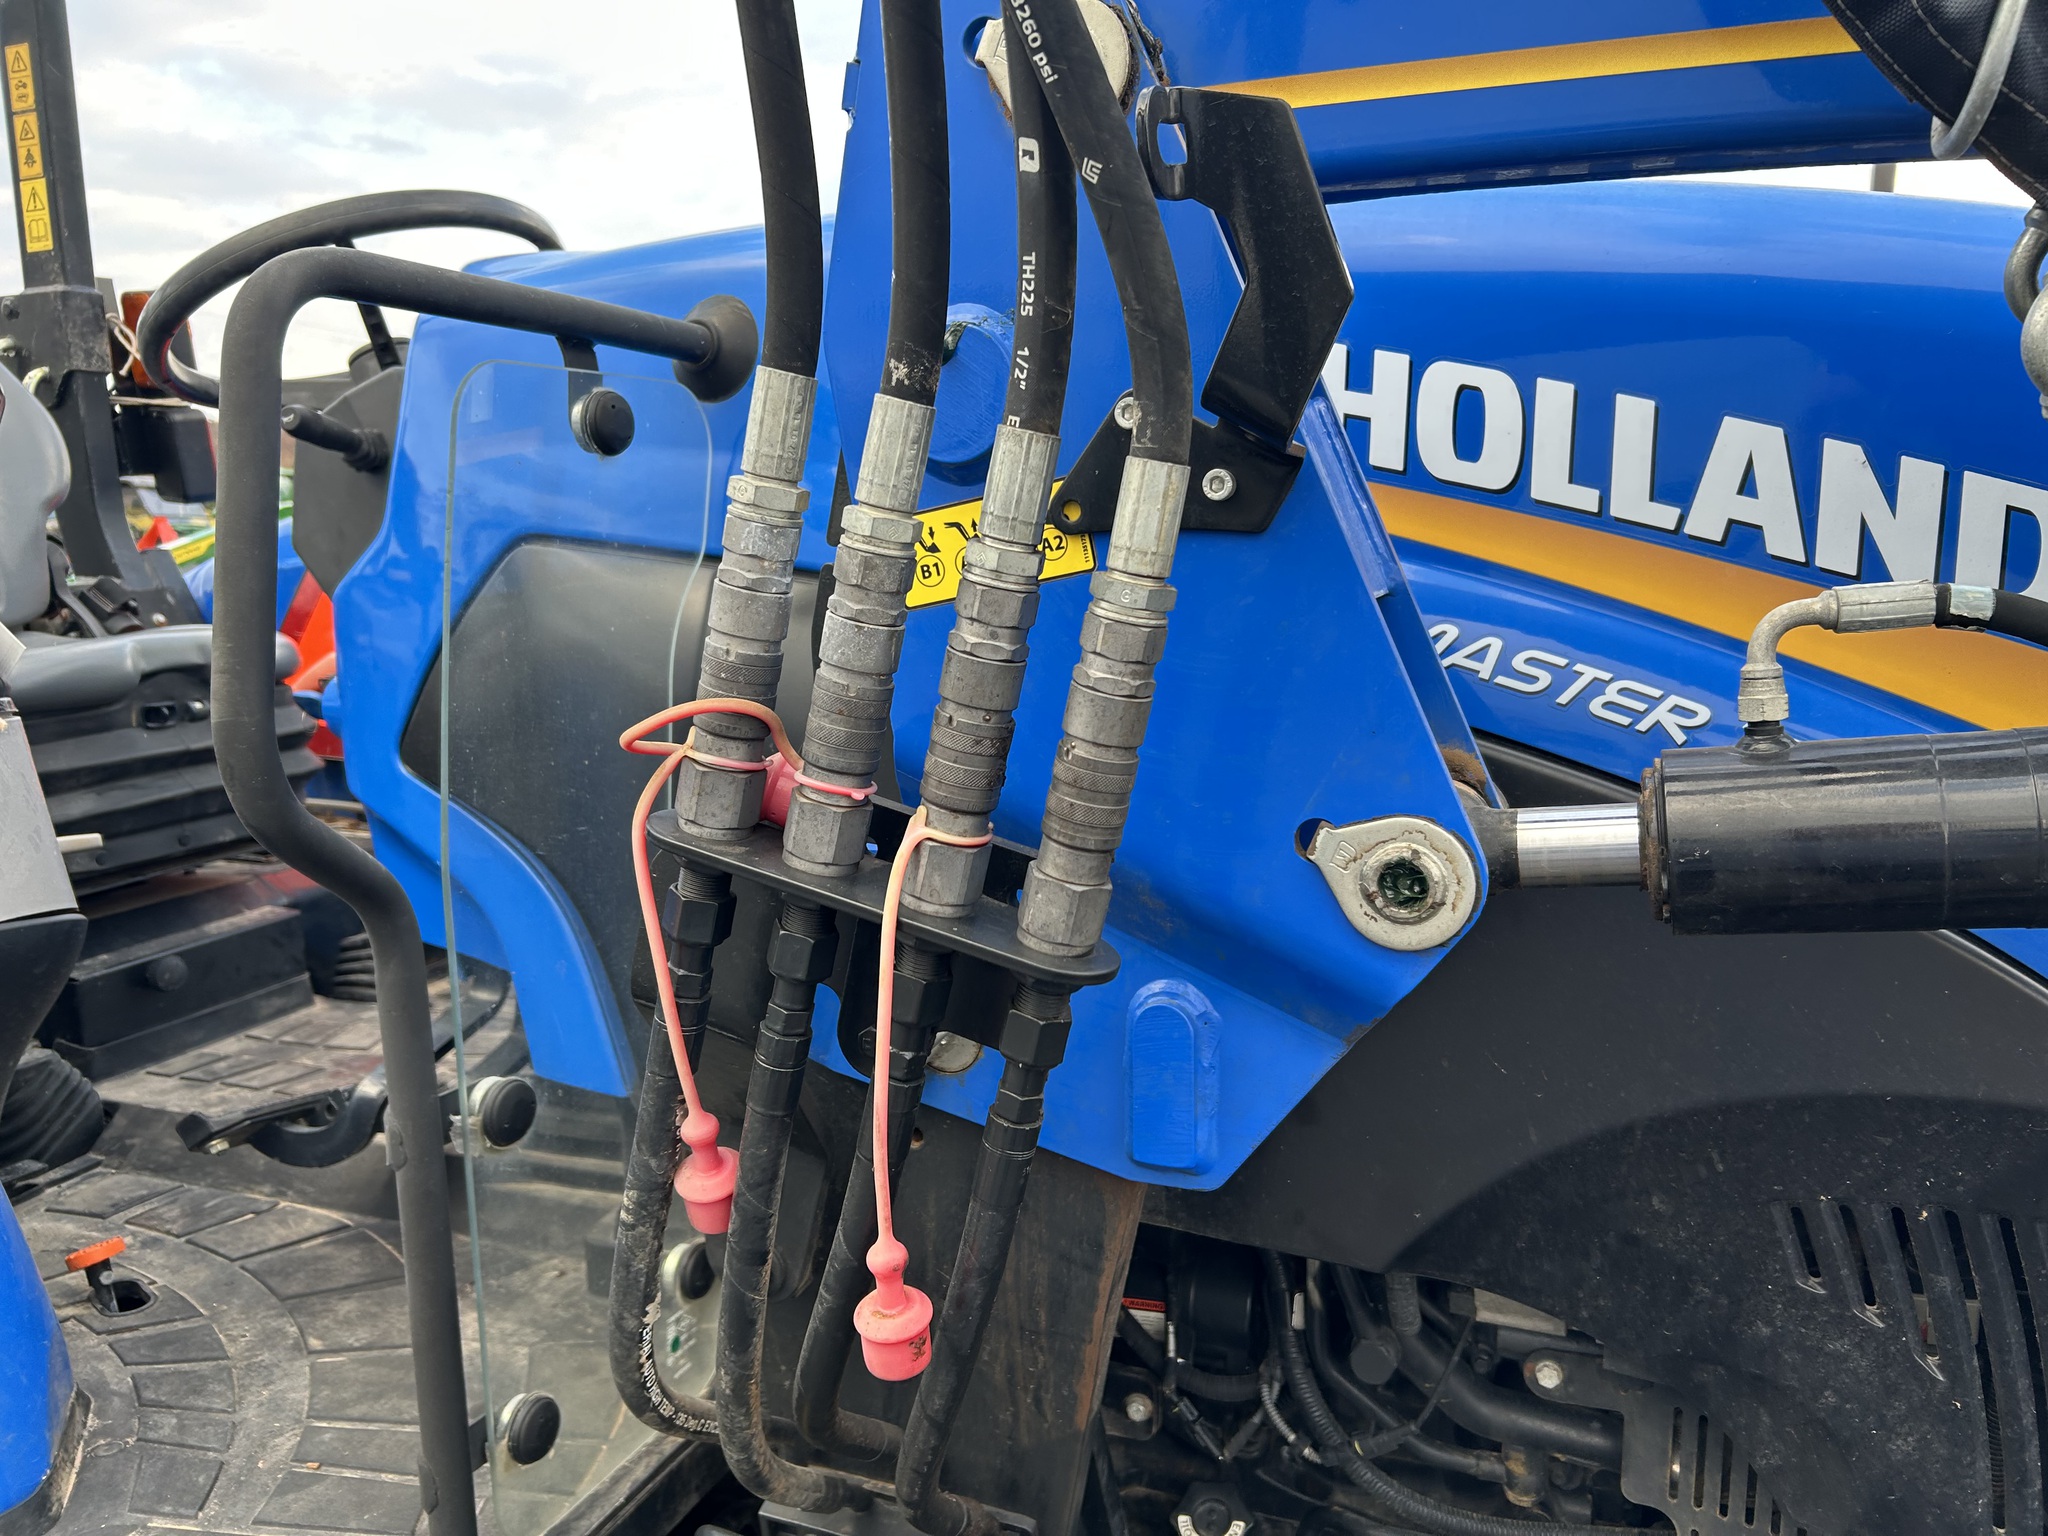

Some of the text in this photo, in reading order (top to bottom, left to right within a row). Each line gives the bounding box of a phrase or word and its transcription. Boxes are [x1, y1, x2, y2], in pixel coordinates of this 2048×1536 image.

[1032, 52, 1059, 84] psi
[1020, 251, 1036, 317] TH225
[1014, 346, 1030, 391] 1/2"
[1321, 342, 2048, 602] HOLLAND
[1041, 535, 1065, 552] A2
[920, 562, 941, 580] B1
